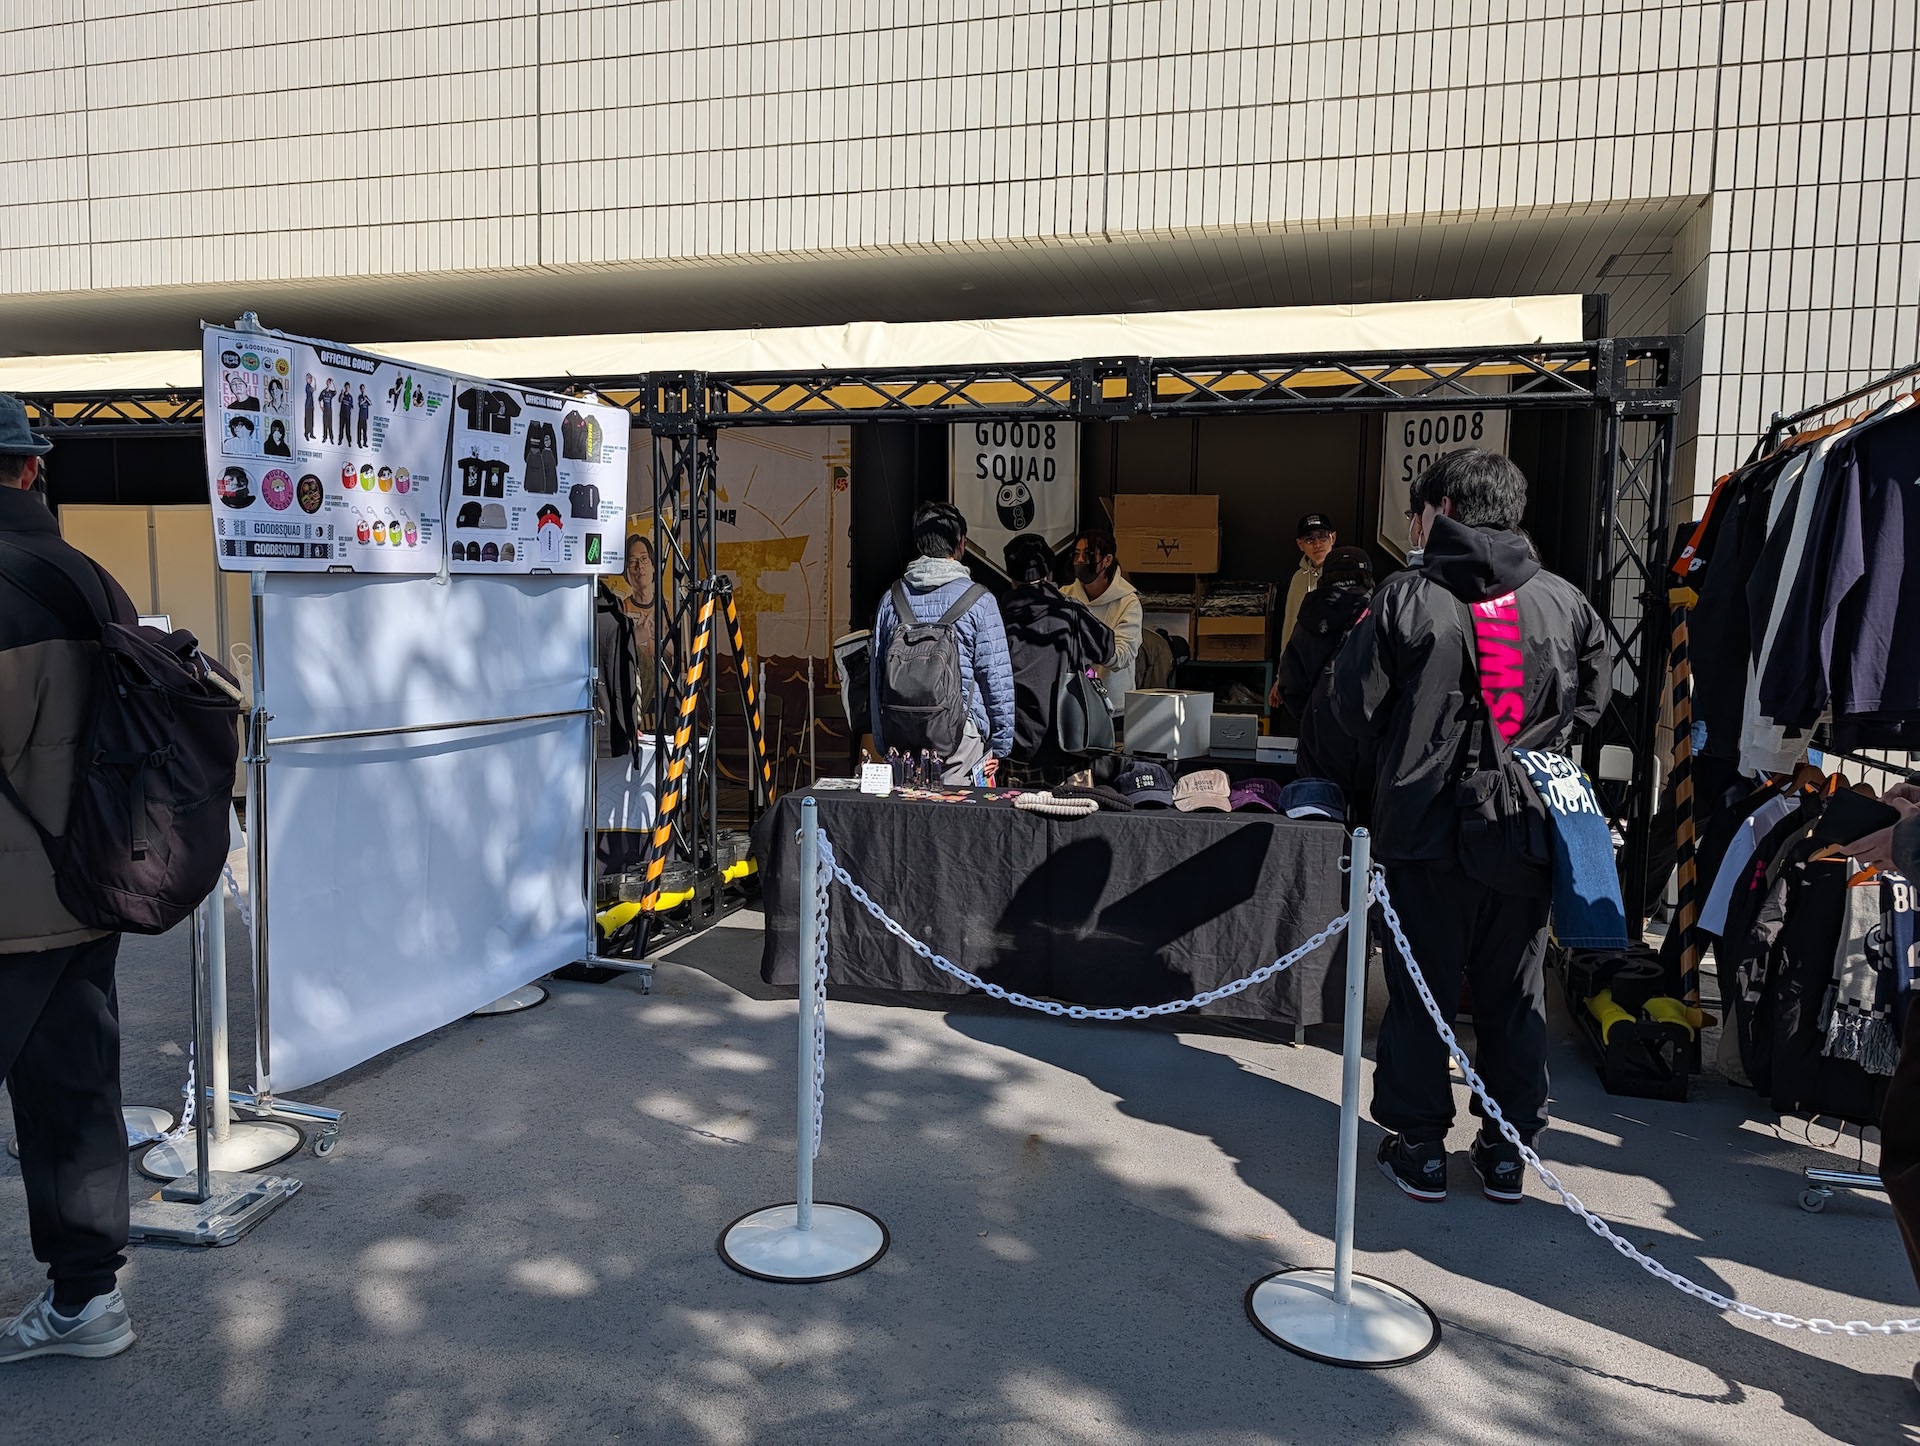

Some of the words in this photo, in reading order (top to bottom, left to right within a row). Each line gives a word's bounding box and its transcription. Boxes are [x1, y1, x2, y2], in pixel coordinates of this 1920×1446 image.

[320, 350, 352, 367] OFFICIAL
[352, 358, 375, 372] GOODS
[525, 394, 546, 406] OFFICIAL
[546, 398, 563, 409] GOODS
[975, 421, 1056, 450] GOOD8
[1404, 411, 1484, 447] GOOD8
[976, 453, 1056, 485] SQUAD
[254, 522, 301, 537] GOOD8SQUAD
[253, 543, 300, 557] GOOD8SQUAD
[1426, 1159, 1441, 1167] NIKE
[1499, 1161, 1515, 1169] NIKE
